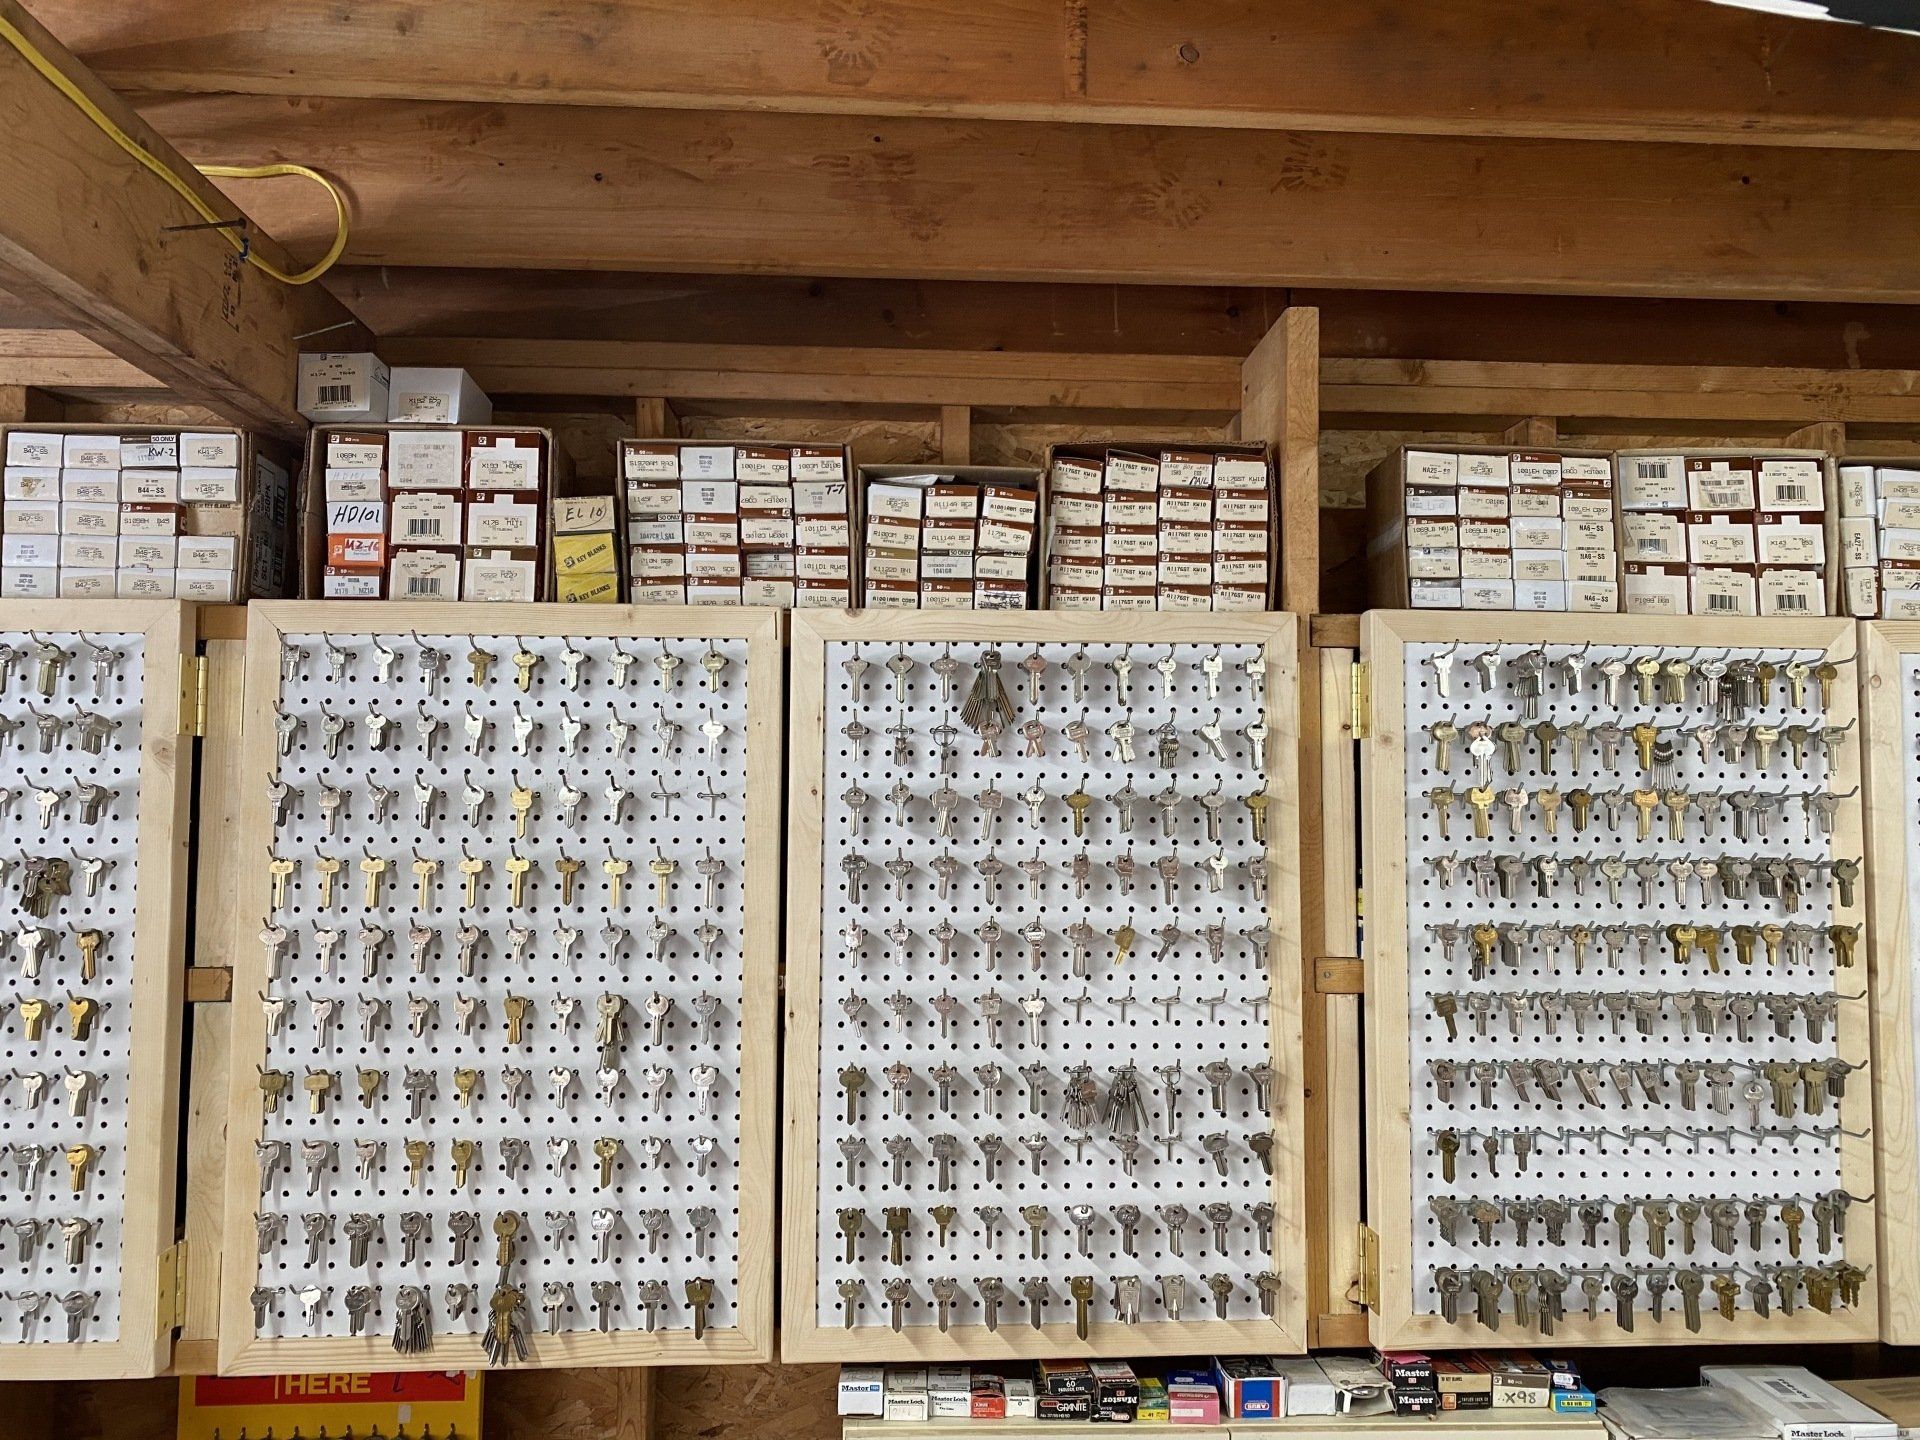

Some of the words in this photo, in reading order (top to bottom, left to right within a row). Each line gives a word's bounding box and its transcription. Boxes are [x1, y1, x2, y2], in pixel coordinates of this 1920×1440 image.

[148, 448, 176, 457] KW-2
[1189, 476, 1209, 485] MAIL
[825, 484, 845, 495] T-7
[333, 504, 380, 525] HD101
[1395, 1369, 1430, 1377] Master
[284, 1373, 371, 1395] HERE
[1505, 1391, 1536, 1404] X98
[1057, 1403, 1087, 1412] GRANITE
